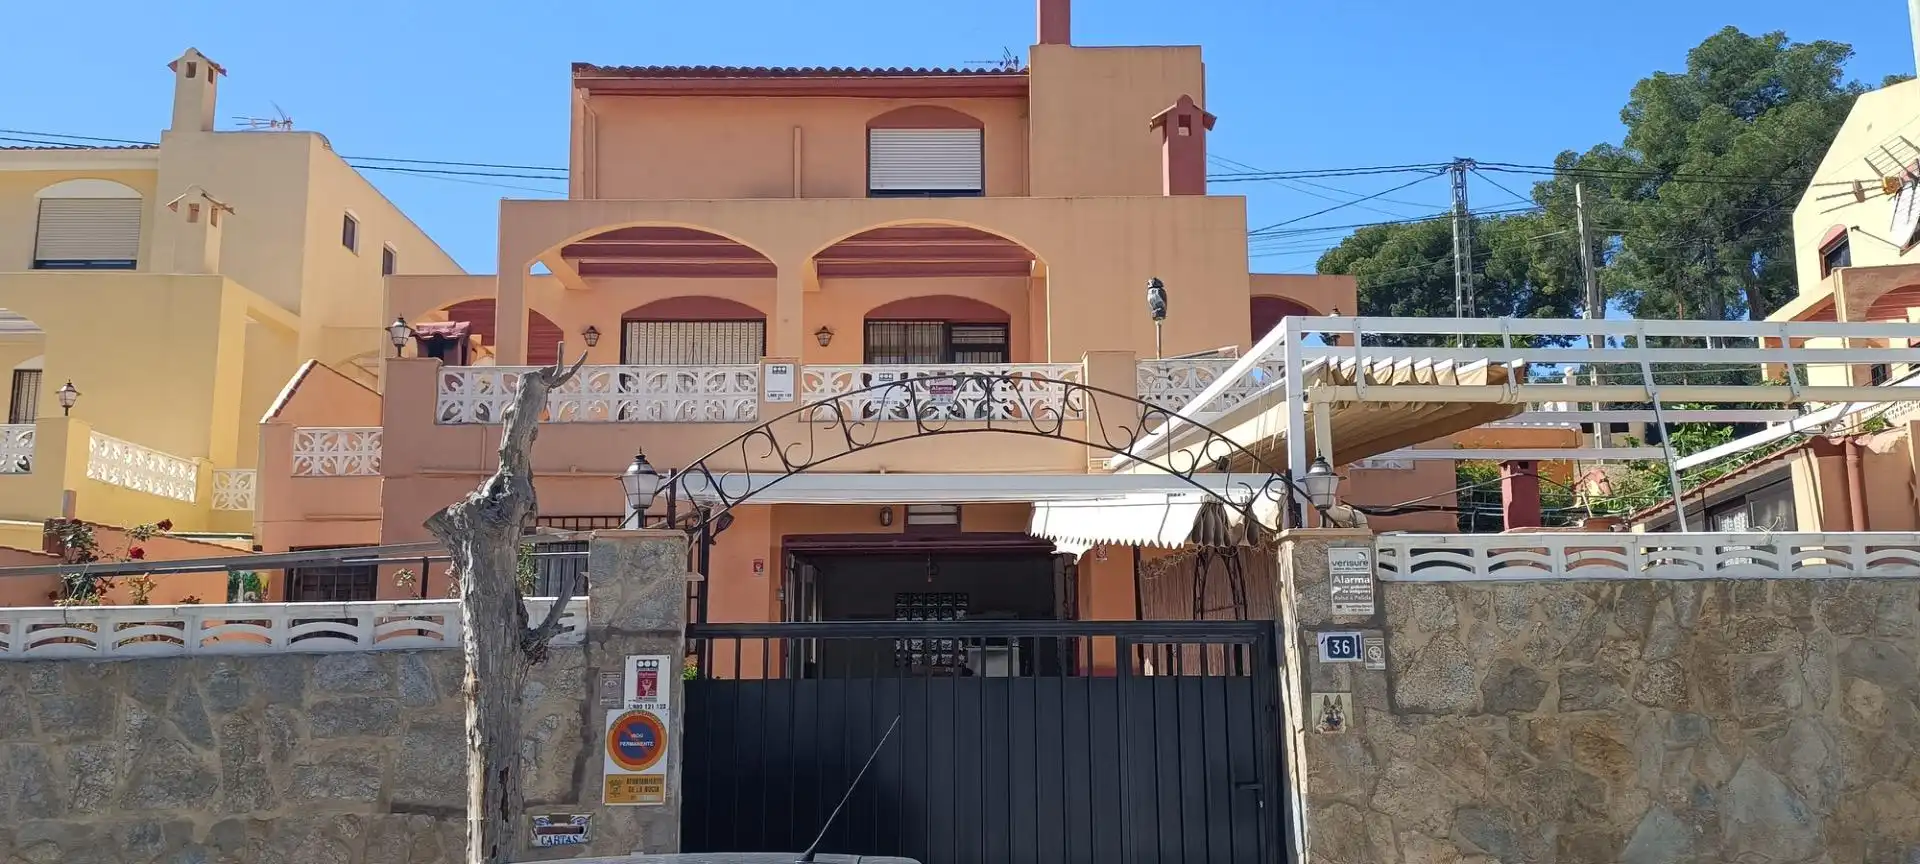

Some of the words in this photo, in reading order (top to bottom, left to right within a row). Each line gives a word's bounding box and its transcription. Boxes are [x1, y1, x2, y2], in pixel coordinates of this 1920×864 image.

[1331, 559, 1369, 567] verisure
[1333, 575, 1370, 584] Alarma
[1332, 639, 1350, 655] 36
[541, 834, 579, 847] CARTAS
